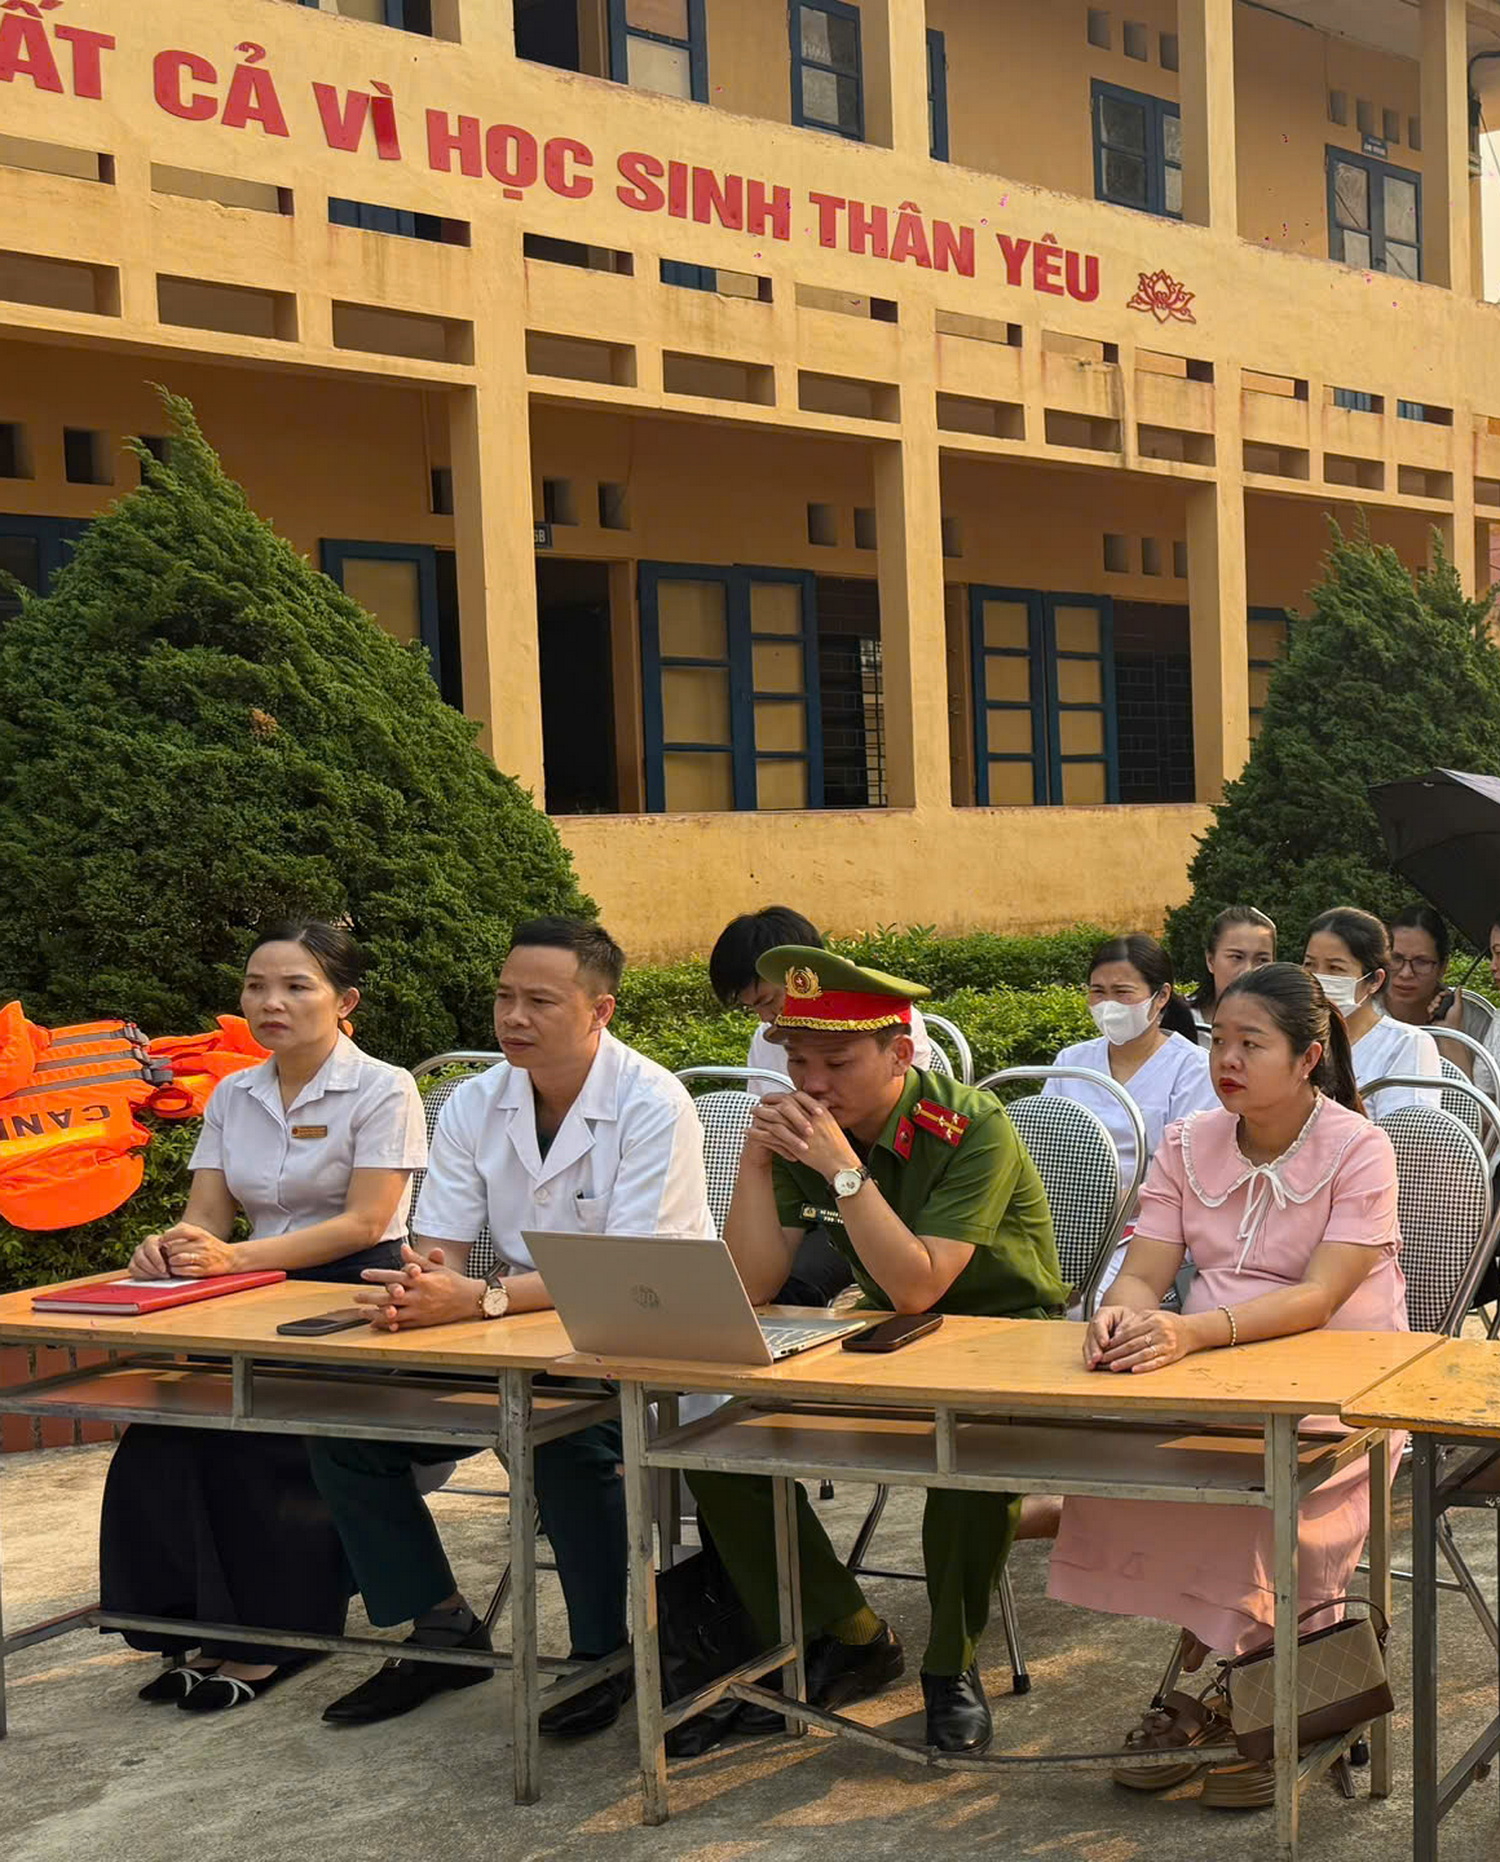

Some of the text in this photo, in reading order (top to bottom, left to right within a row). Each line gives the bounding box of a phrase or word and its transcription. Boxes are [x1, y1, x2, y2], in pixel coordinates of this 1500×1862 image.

[153, 42, 290, 137] CẢ
[312, 81, 401, 160] VÌ
[426, 109, 593, 200] HỌC
[617, 153, 791, 241] SINH
[809, 192, 975, 278] THÂN
[997, 233, 1100, 303] YÊU
